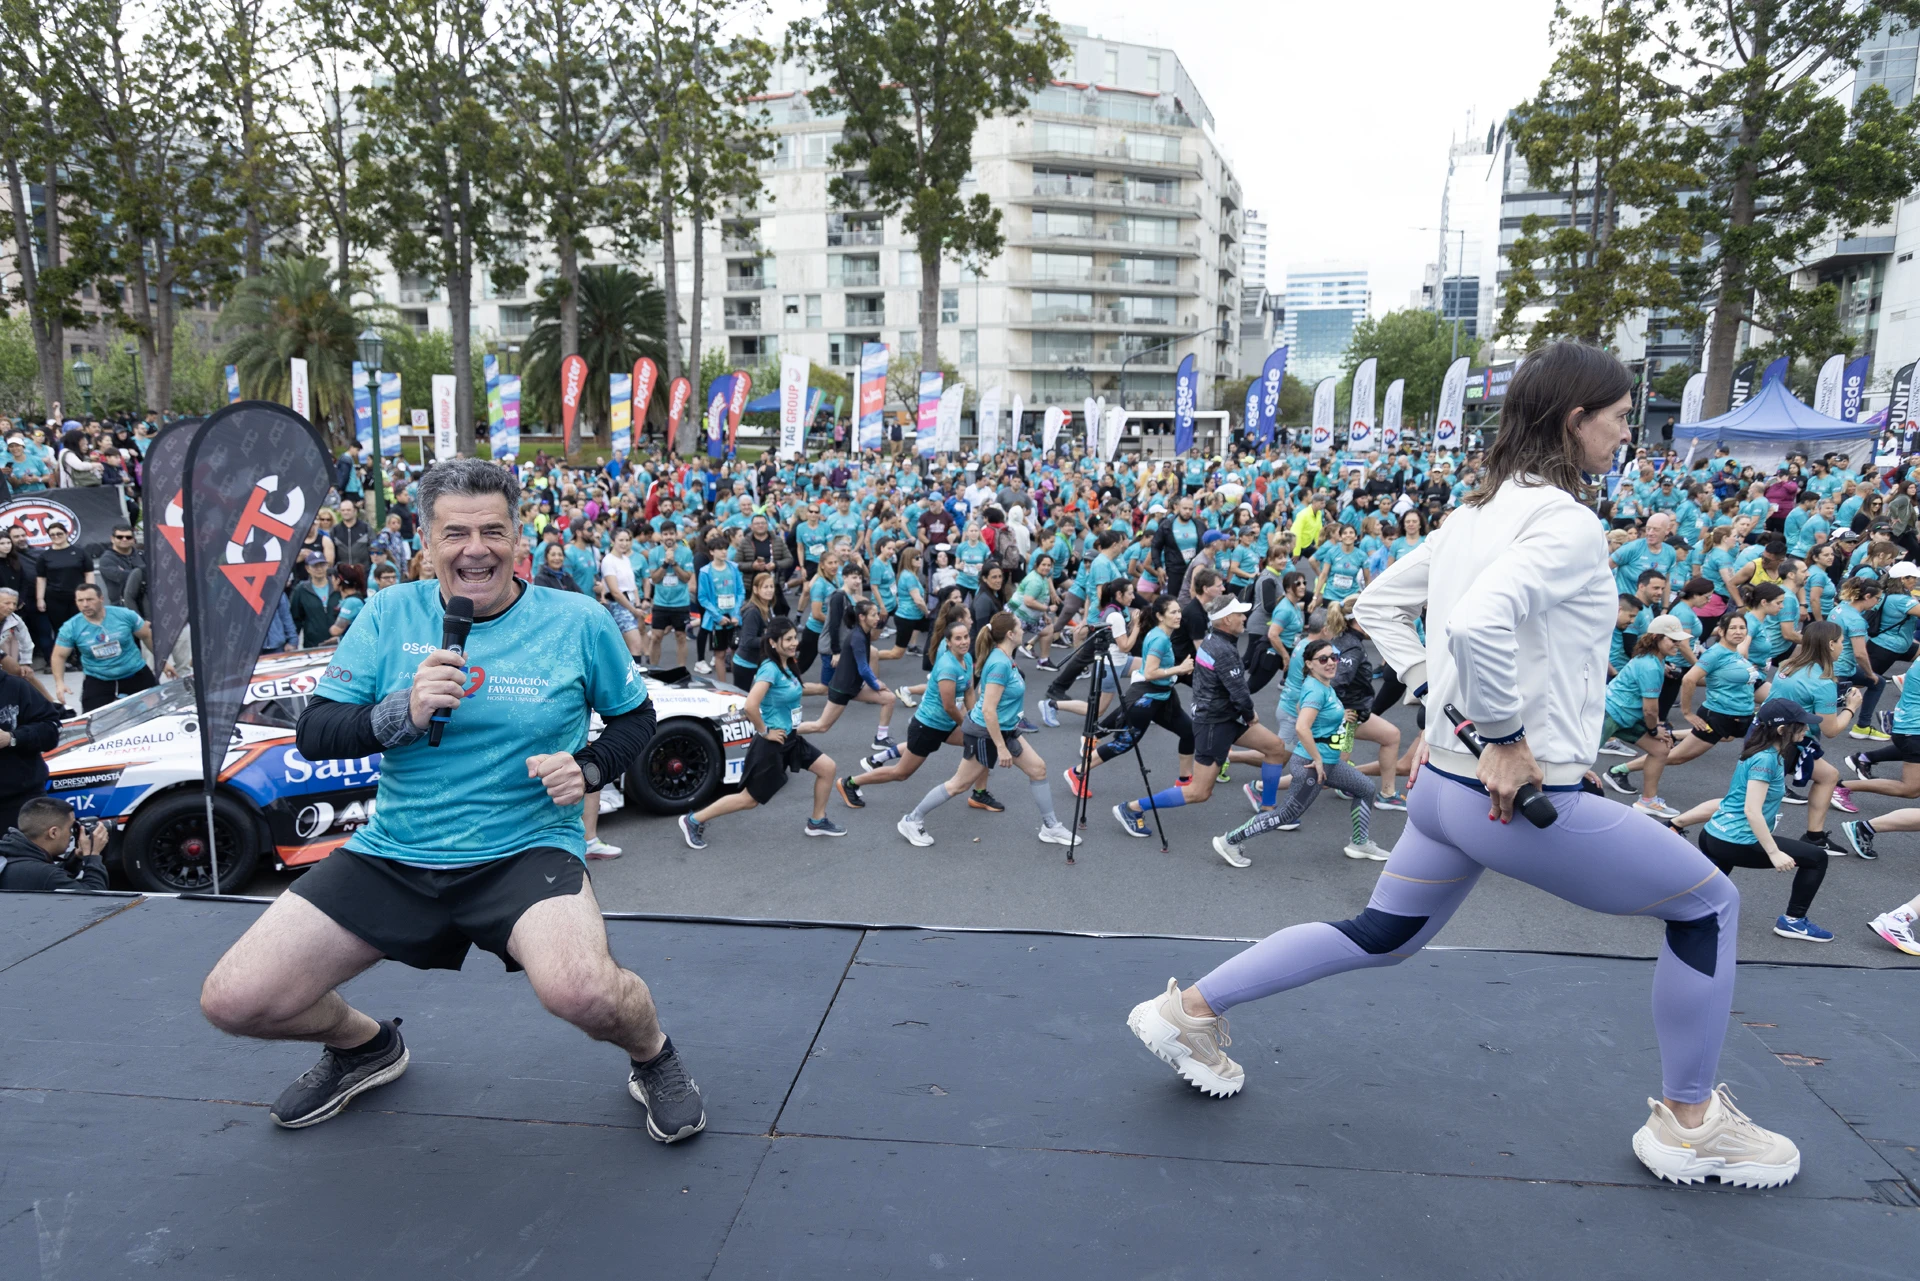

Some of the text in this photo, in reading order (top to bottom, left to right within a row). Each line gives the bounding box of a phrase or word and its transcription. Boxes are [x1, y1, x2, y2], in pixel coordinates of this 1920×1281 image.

[564, 358, 582, 408] Dexter
[633, 361, 652, 410] Dexter
[669, 379, 687, 421] Dexter
[729, 374, 747, 415] Dexter
[1264, 368, 1281, 417] osde
[1844, 376, 1861, 418] osde
[441, 399, 451, 449] TAG GROUP
[784, 385, 801, 448] TAG GROUP
[1247, 395, 1259, 427] osde
[218, 475, 305, 615] ACTC
[402, 642, 438, 655] osde
[487, 686, 540, 696] FAVALORO
[489, 675, 550, 687] FUNDACIÓN
[88, 731, 174, 753] BARBAGALLO
[1244, 815, 1280, 837] GAME ON
